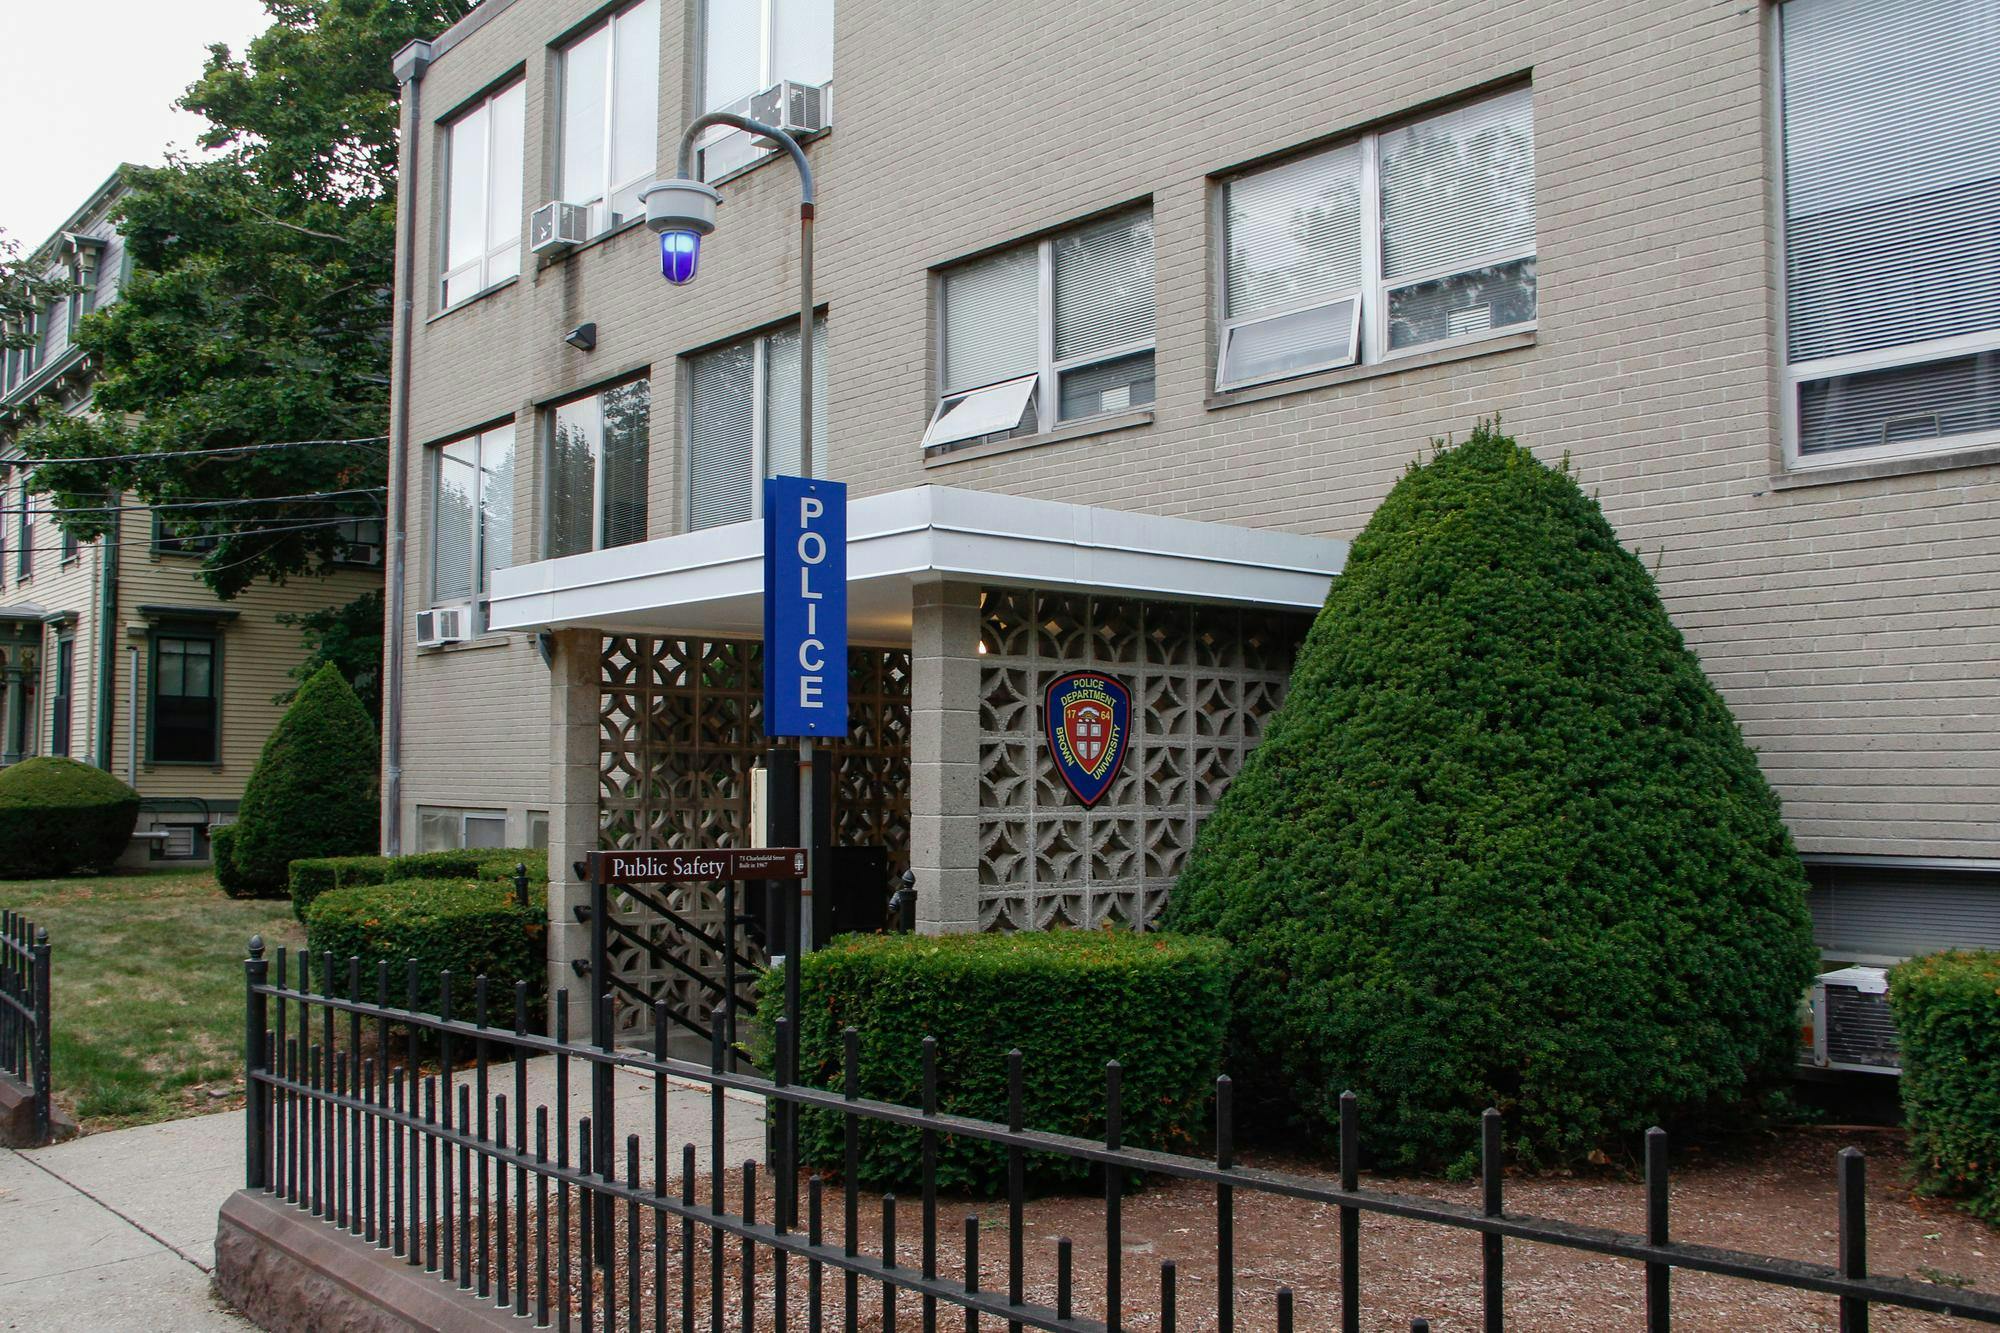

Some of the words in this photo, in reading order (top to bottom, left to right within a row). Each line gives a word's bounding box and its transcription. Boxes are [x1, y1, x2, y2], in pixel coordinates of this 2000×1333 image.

[797, 497, 827, 708] POLICE
[1073, 678, 1105, 690] POLICE
[1060, 689, 1117, 706] DEPARTMENT
[1067, 709, 1077, 719] 17
[1101, 711, 1110, 720] 64
[1056, 726, 1075, 767] BROWN
[1092, 724, 1120, 780] UNIVERSITY
[612, 857, 668, 877] Public
[673, 856, 725, 879] Safety
